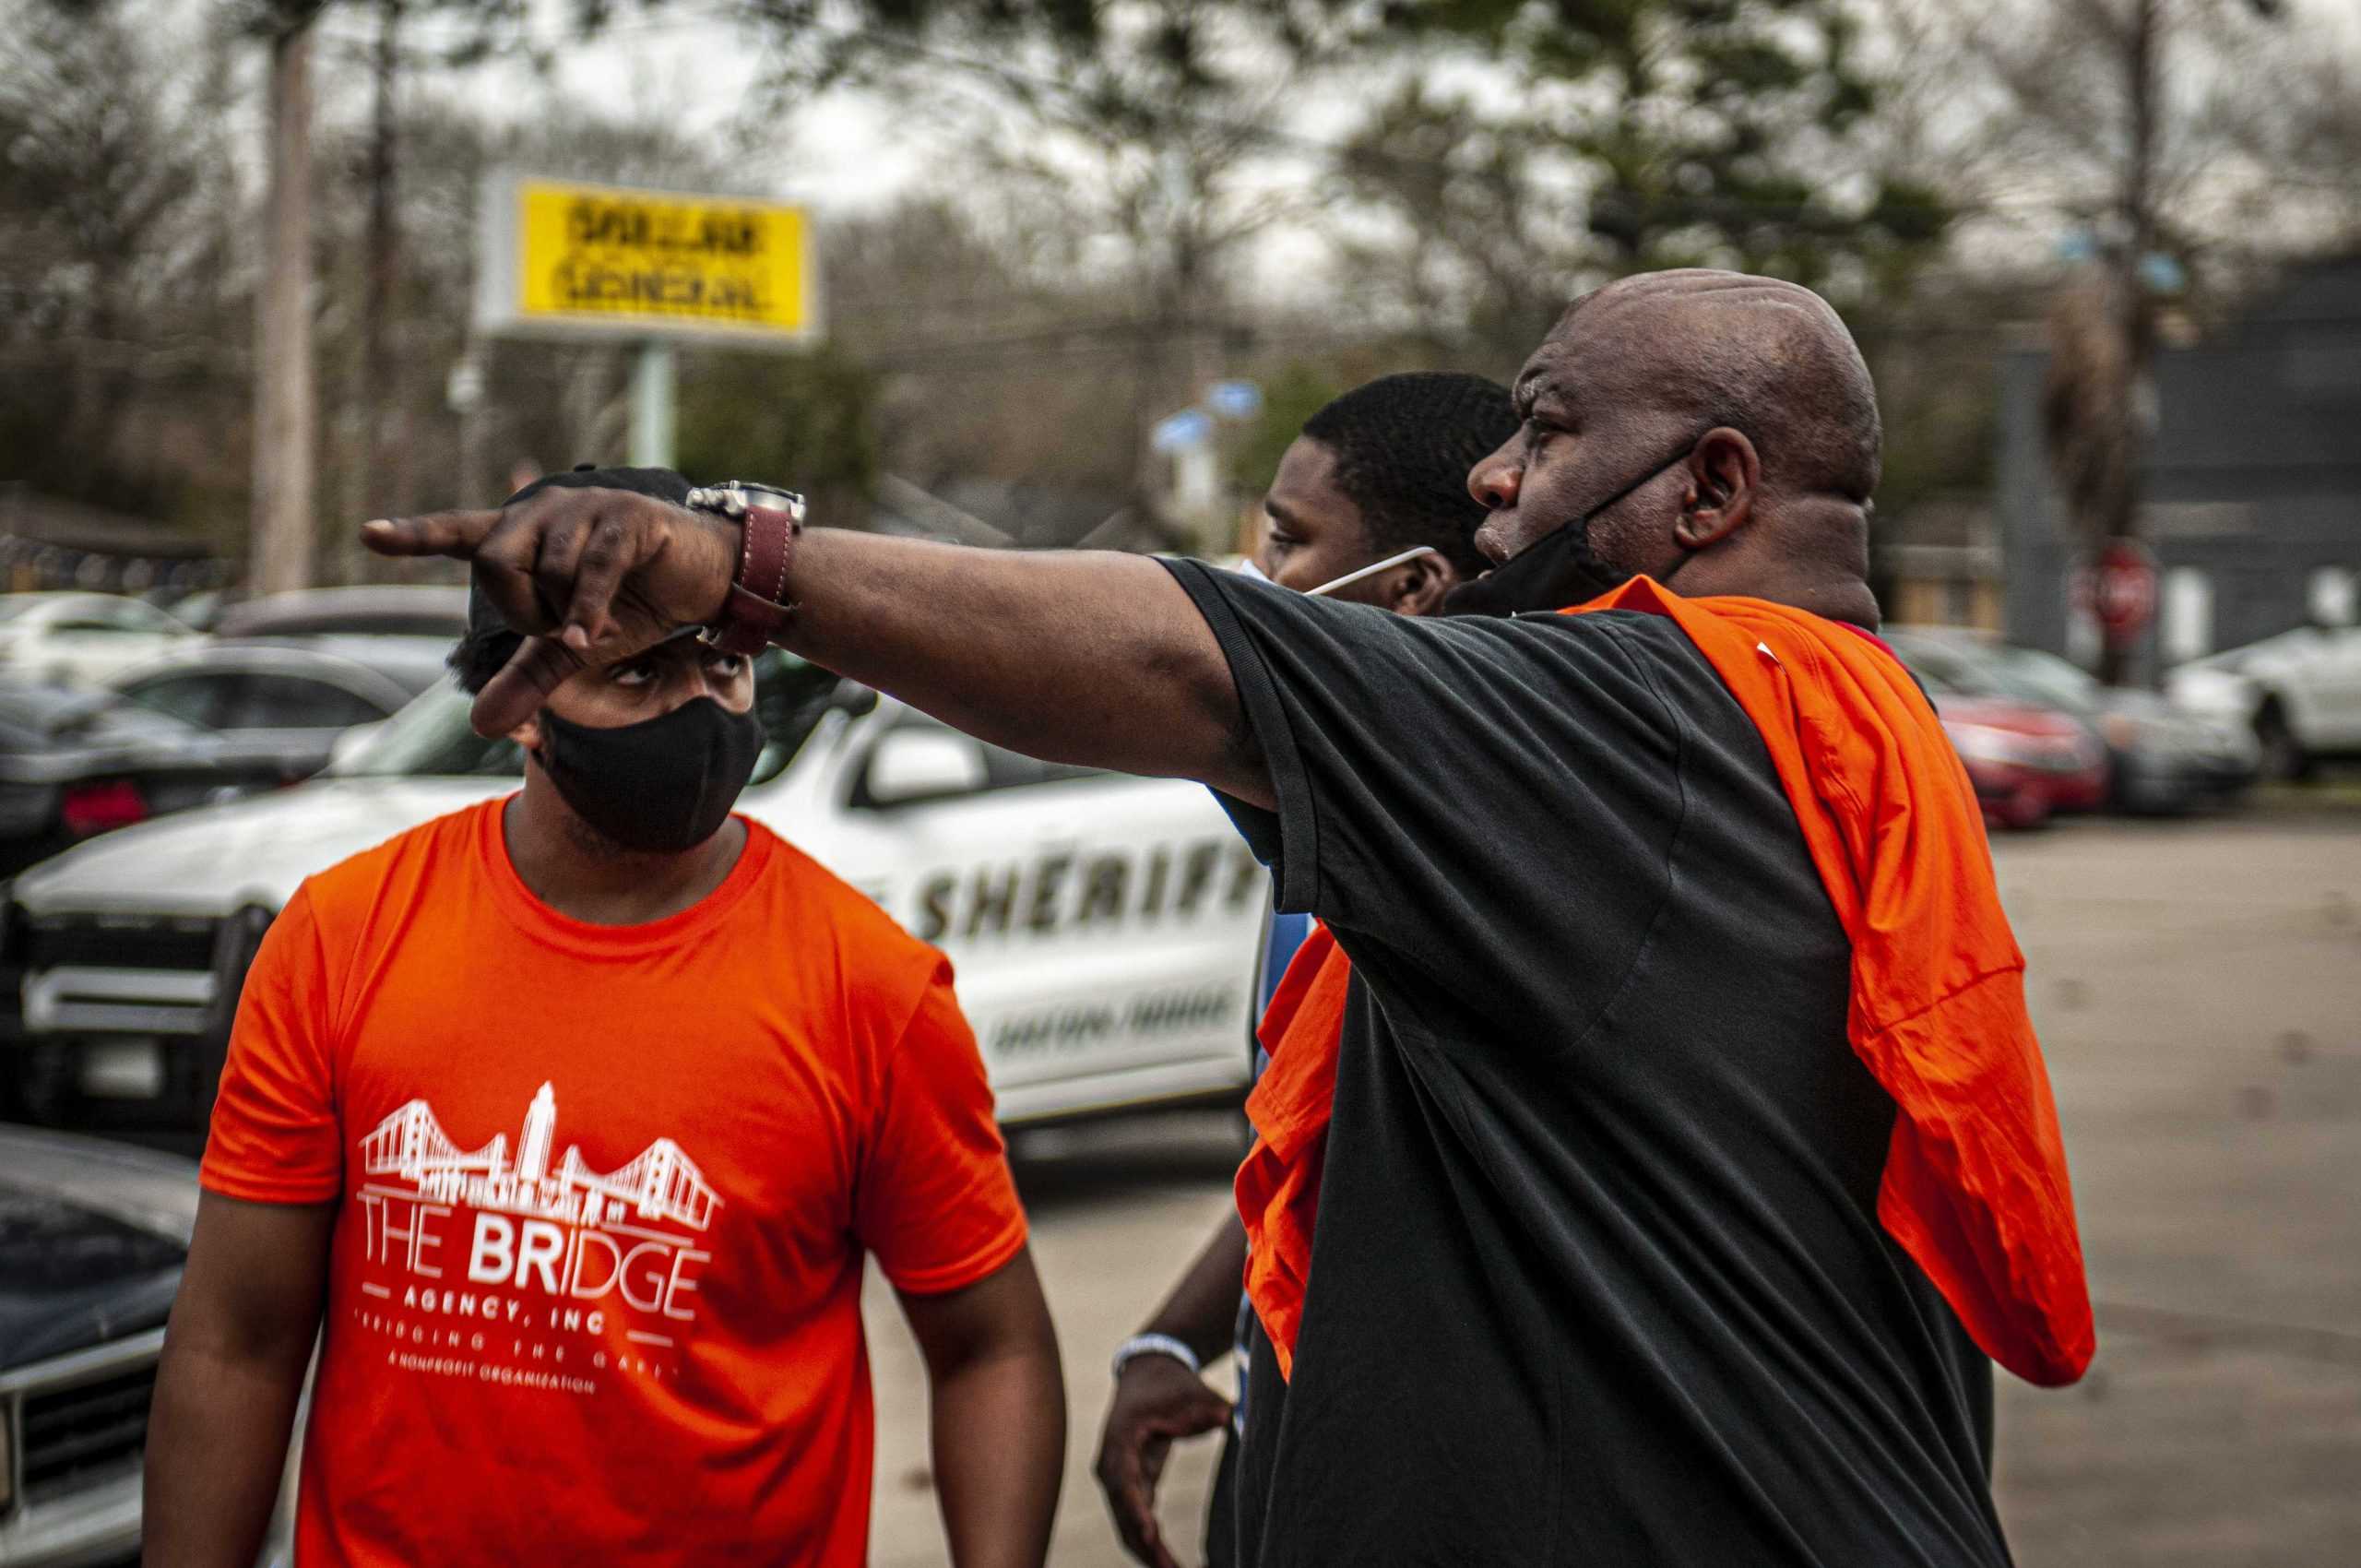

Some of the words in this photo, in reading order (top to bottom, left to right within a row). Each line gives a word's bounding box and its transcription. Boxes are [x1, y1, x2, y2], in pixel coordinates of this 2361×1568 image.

[357, 1192, 452, 1278] THE
[468, 1212, 711, 1321] BRIDGE
[404, 1284, 531, 1328] AGENCY,
[551, 1307, 606, 1335] INC
[387, 1348, 397, 1366] A
